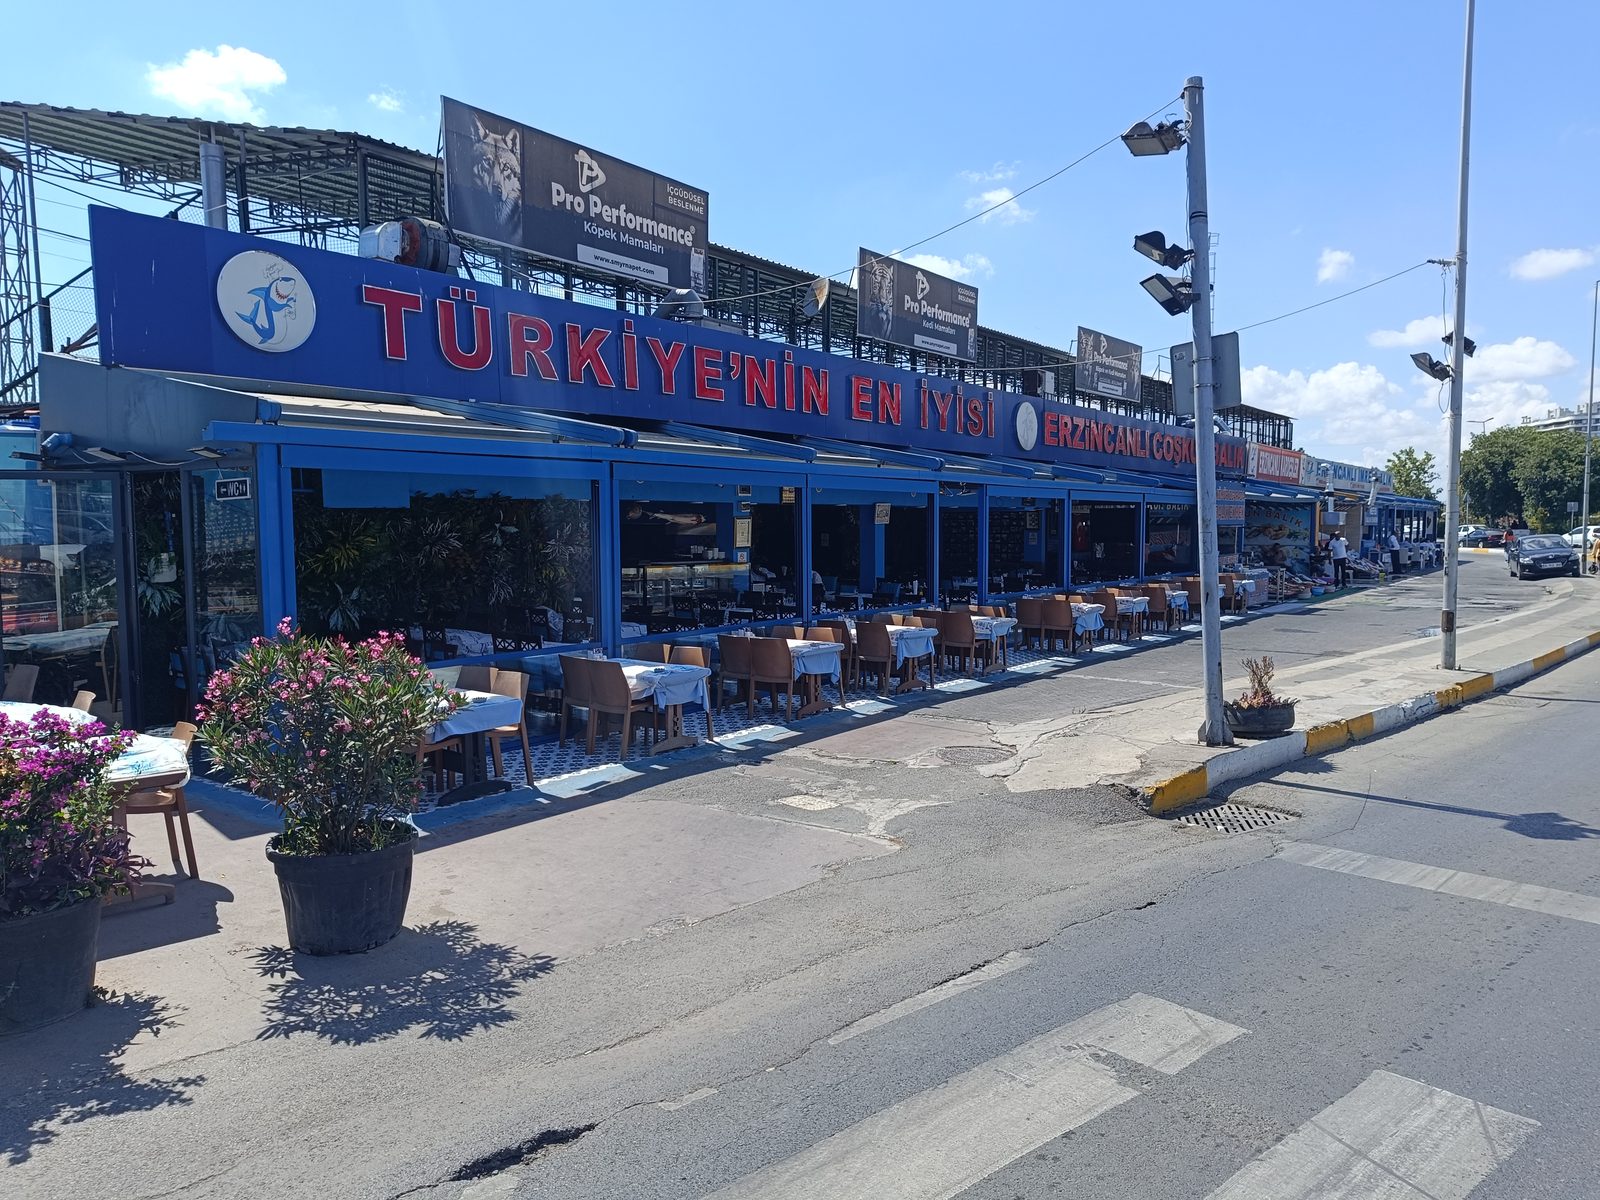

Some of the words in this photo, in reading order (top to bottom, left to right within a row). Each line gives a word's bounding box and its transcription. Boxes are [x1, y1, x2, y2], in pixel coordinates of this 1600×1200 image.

[551, 182, 585, 214] Pro
[667, 183, 705, 205] İÇGÜDÜSEL
[668, 196, 704, 215] BESLENME
[583, 221, 617, 242] Köpek
[619, 232, 664, 254] Mamaları
[593, 254, 655, 275] www.smyrnapet.com
[904, 294, 919, 314] Pro
[922, 320, 935, 330] Kedi
[362, 284, 829, 416] TÜRKİYE'NİN
[852, 374, 902, 426] EN
[920, 378, 995, 438] İYİSİ
[1044, 411, 1151, 459] ERZİNCANLI
[1152, 431, 1198, 466] COŞKU
[226, 481, 240, 497] WC
